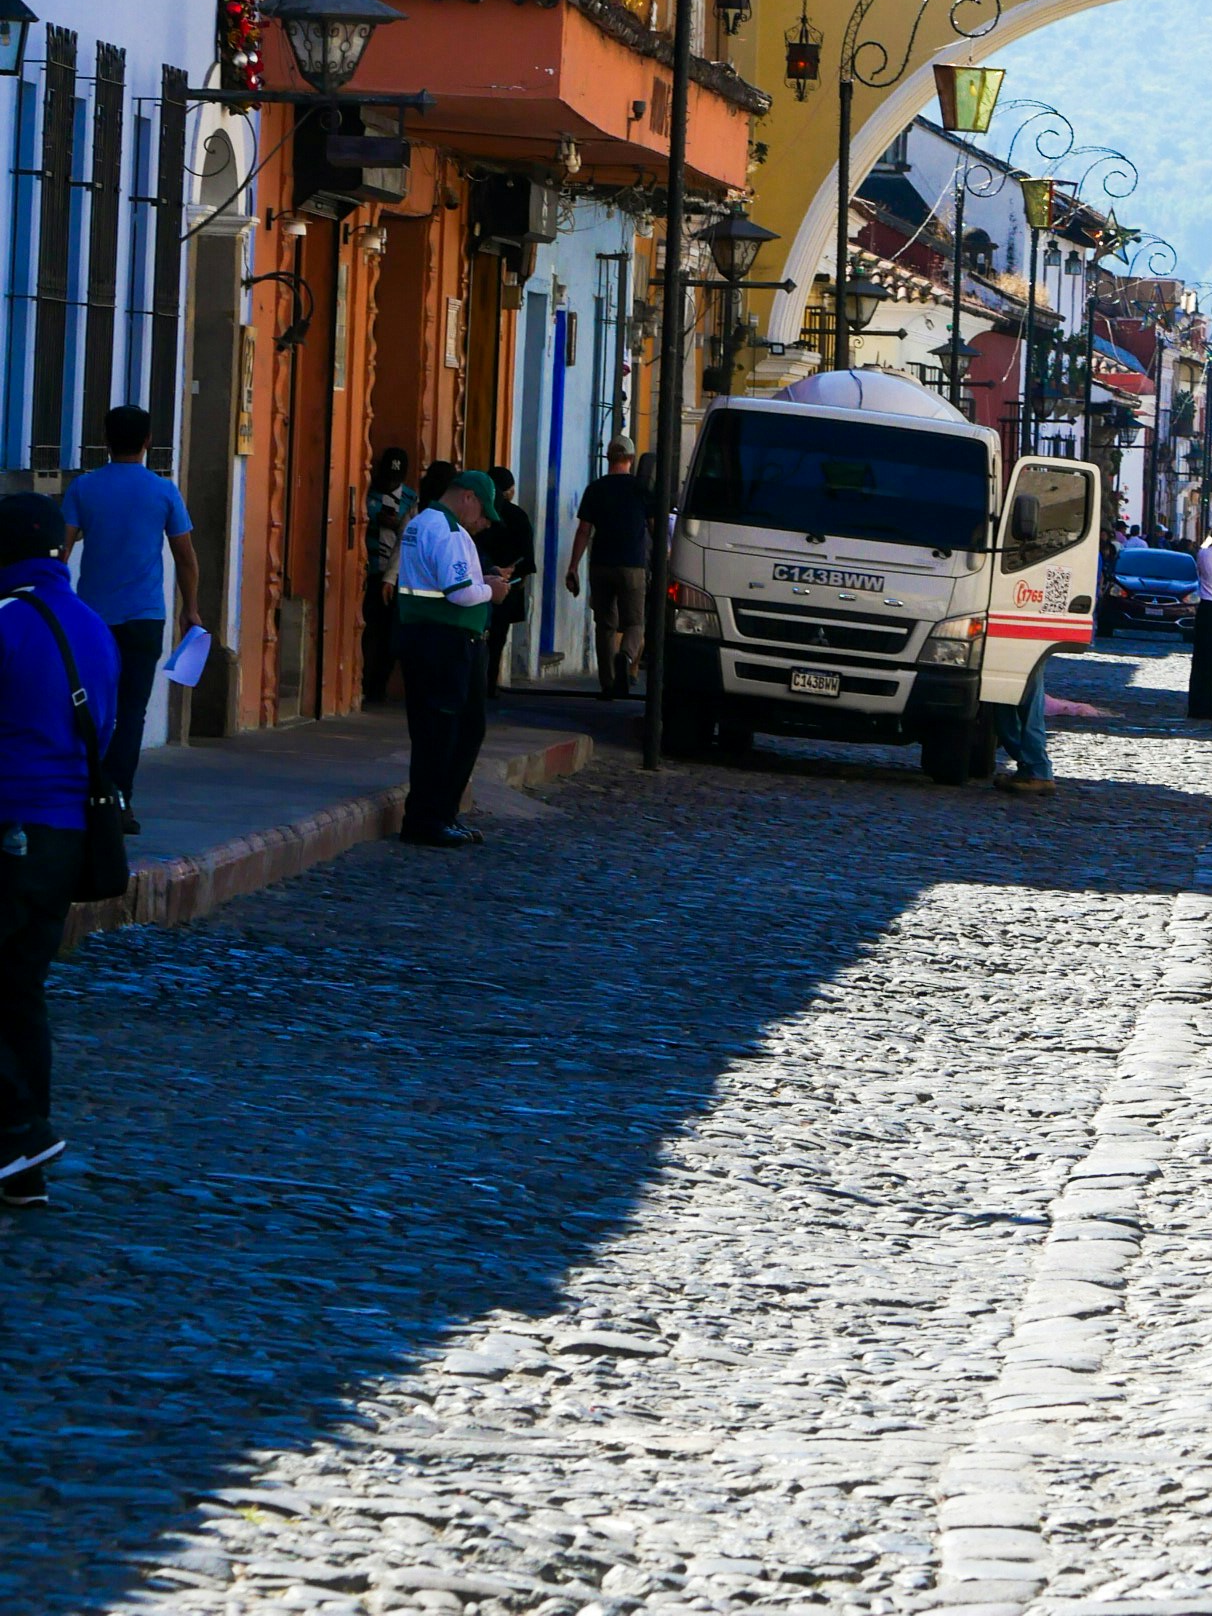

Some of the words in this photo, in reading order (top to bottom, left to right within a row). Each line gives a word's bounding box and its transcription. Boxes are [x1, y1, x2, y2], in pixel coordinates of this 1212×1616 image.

[774, 565, 885, 592] C143BWW
[1022, 590, 1043, 603] 1765
[793, 673, 839, 692] C143BWW
